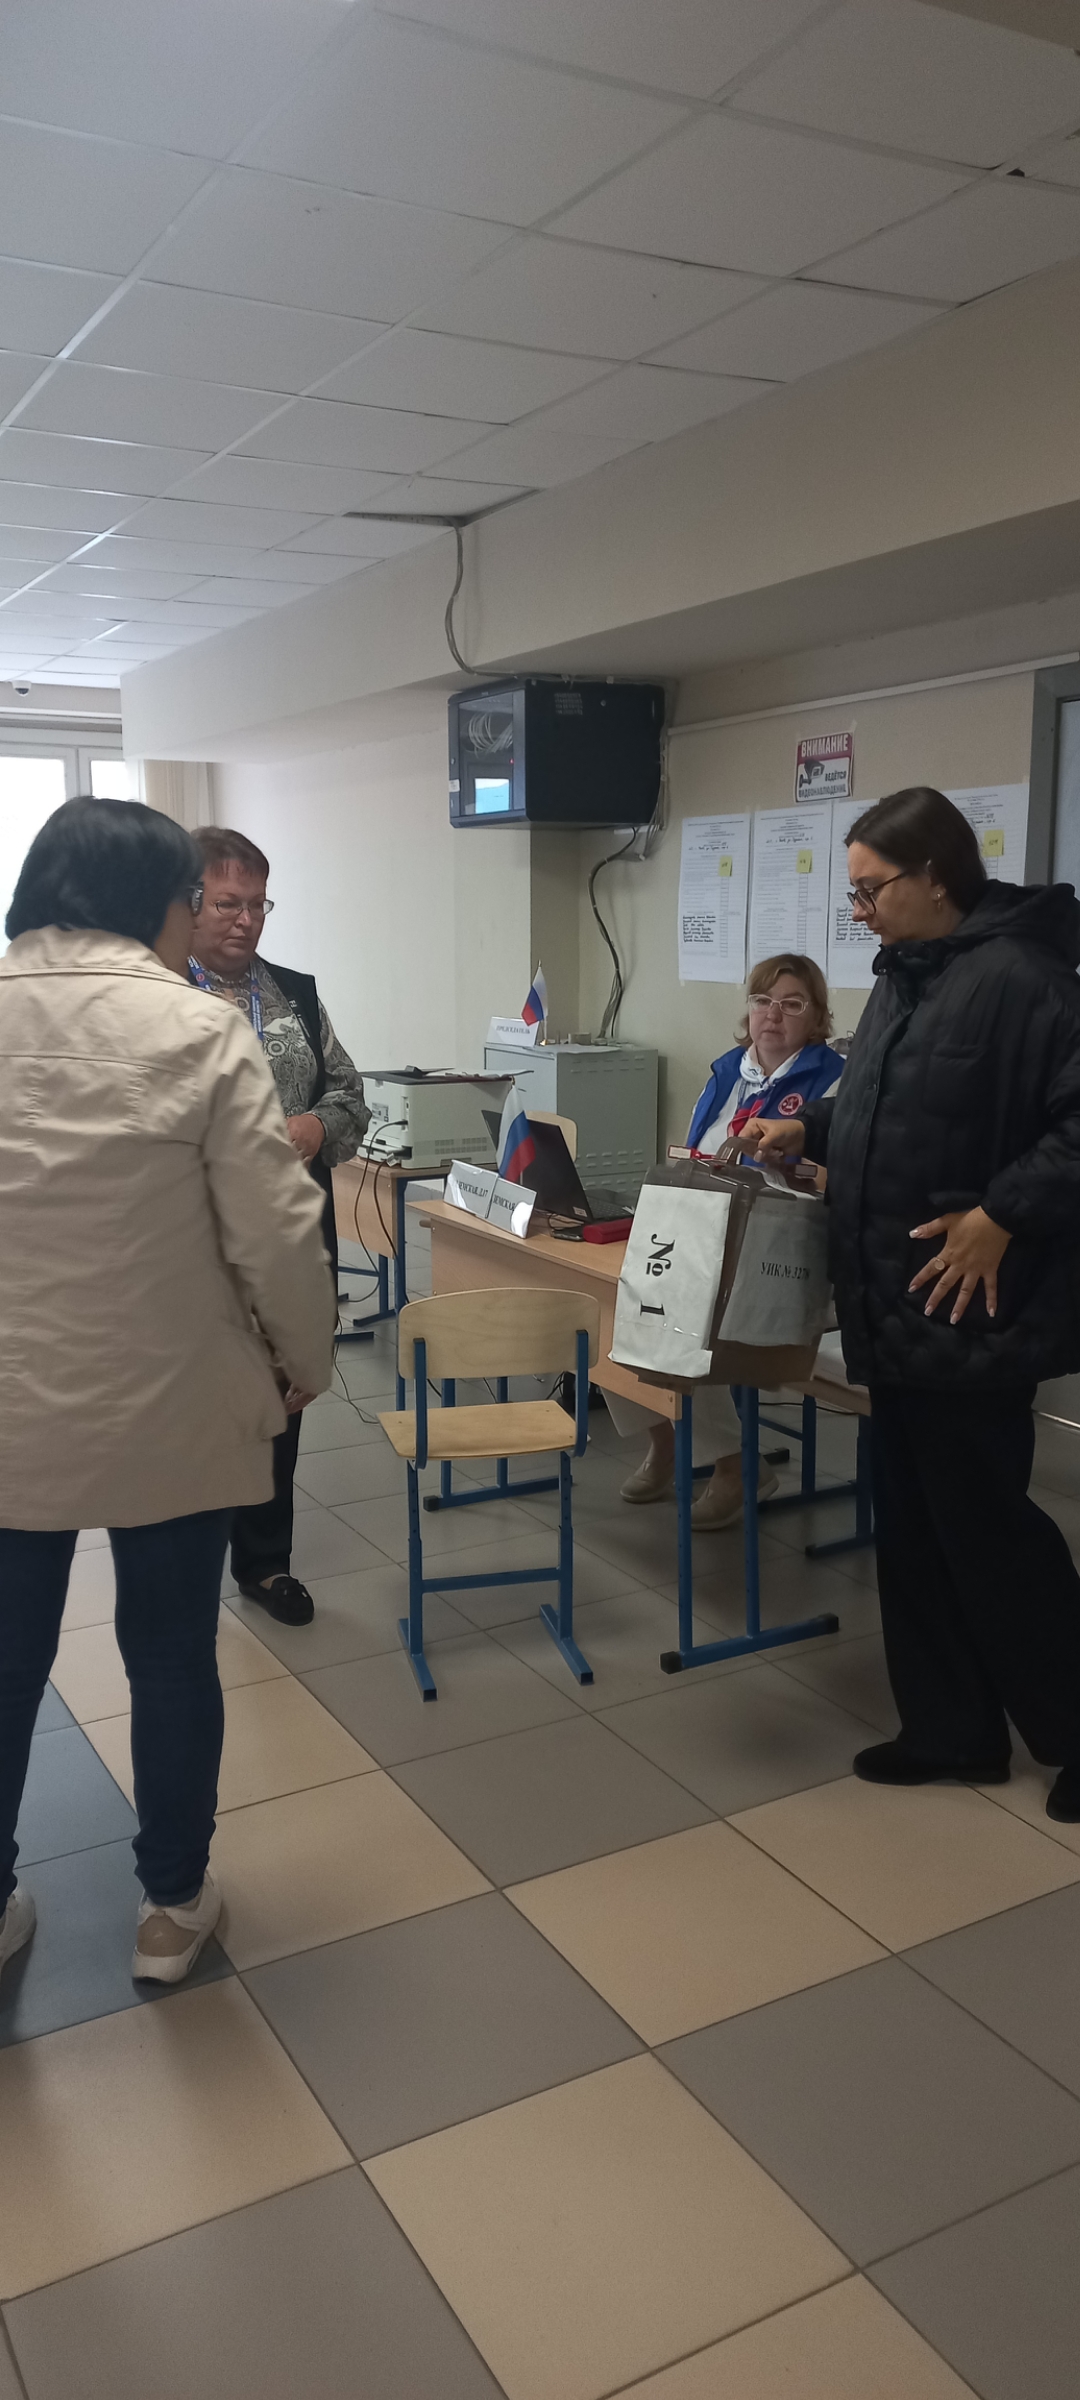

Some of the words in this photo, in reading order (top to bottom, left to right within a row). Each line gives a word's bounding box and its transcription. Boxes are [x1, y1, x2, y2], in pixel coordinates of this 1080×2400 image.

[801, 734, 849, 757] ВНИМАНИЕ
[825, 770, 847, 782] ВЕДЁТСЯ
[646, 1233, 676, 1277] №
[761, 1261, 782, 1277] УИК
[640, 1300, 665, 1316] 1
